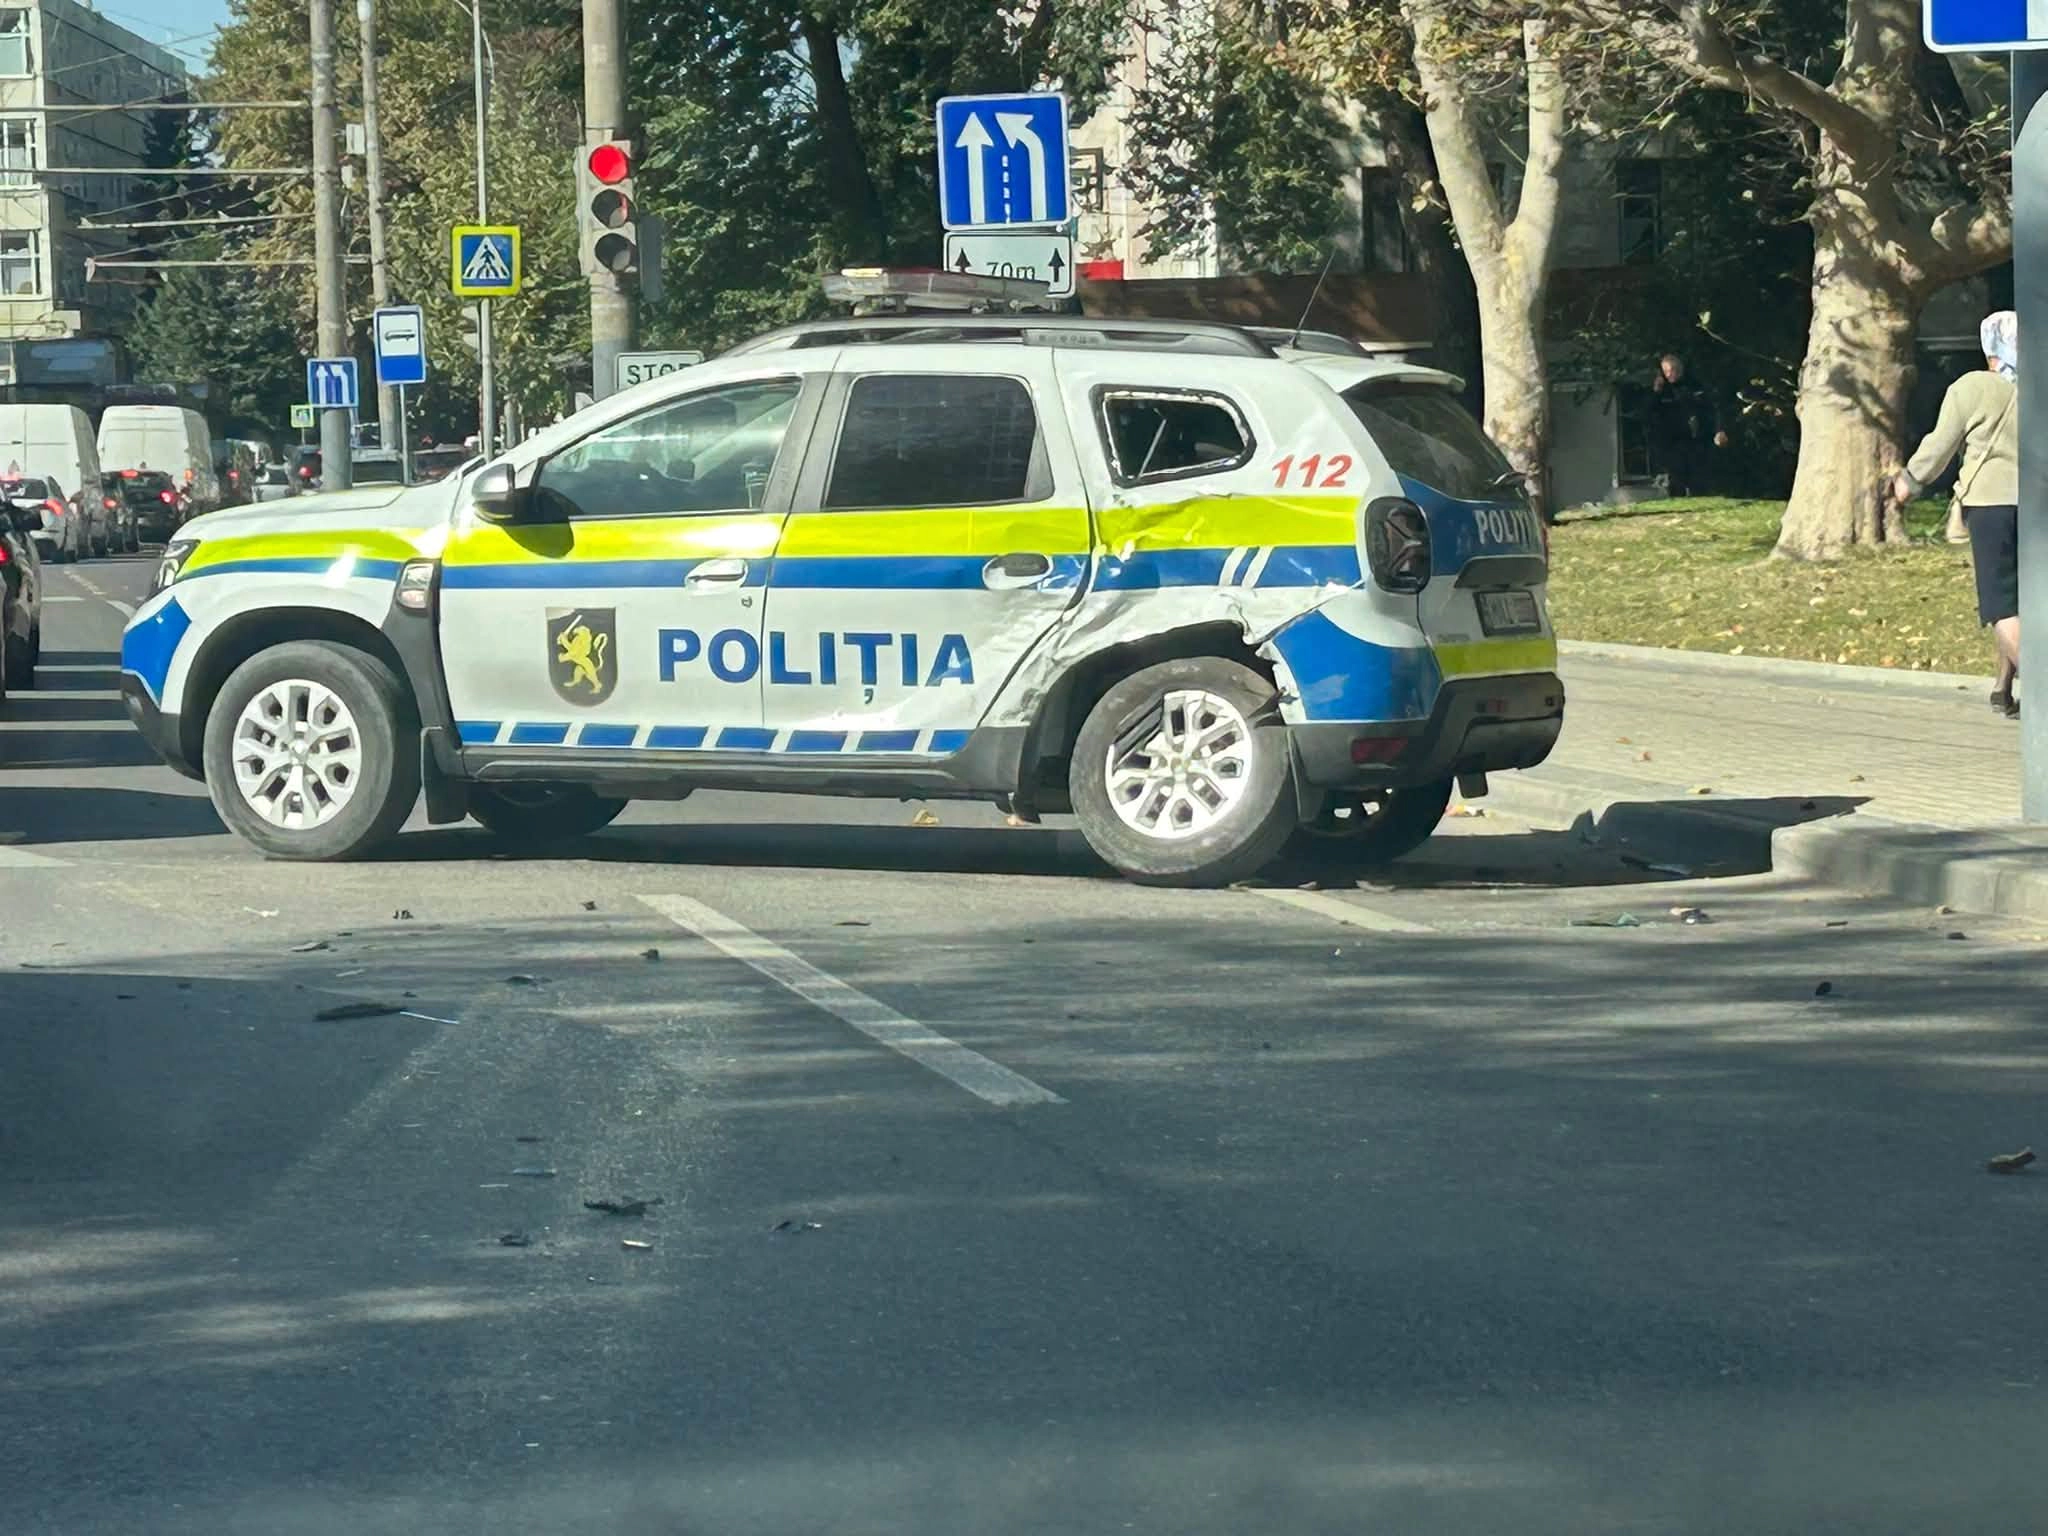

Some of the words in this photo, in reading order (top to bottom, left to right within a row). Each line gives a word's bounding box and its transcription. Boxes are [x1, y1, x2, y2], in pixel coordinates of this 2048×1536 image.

[986, 262, 1035, 281] 70m
[627, 363, 692, 385] STO
[1272, 453, 1353, 488] 112
[658, 628, 975, 705] POLIȚIA
